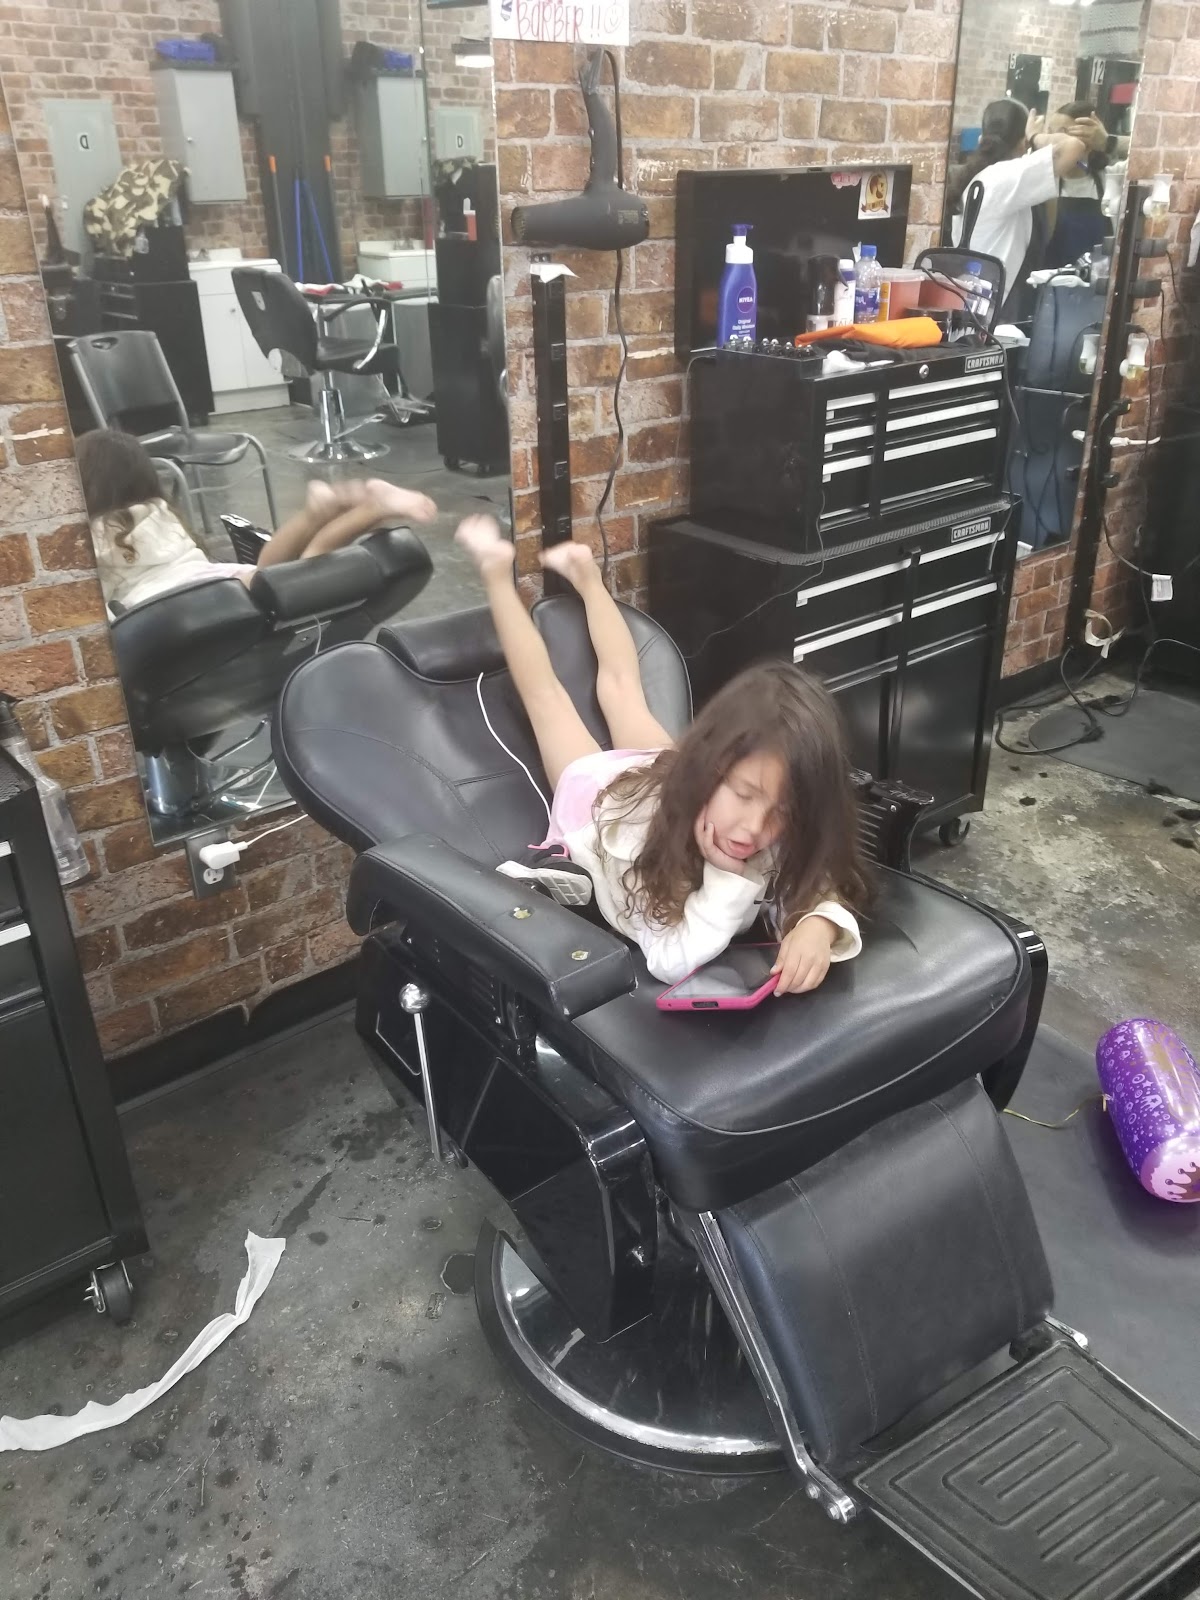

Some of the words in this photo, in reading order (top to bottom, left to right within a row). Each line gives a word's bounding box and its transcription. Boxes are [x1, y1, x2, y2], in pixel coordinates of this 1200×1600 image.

[1092, 59, 1105, 83] 12
[456, 135, 464, 148] D
[967, 354, 1004, 369] CRAFTSMAN
[953, 520, 990, 539] CRAFTSMAN
